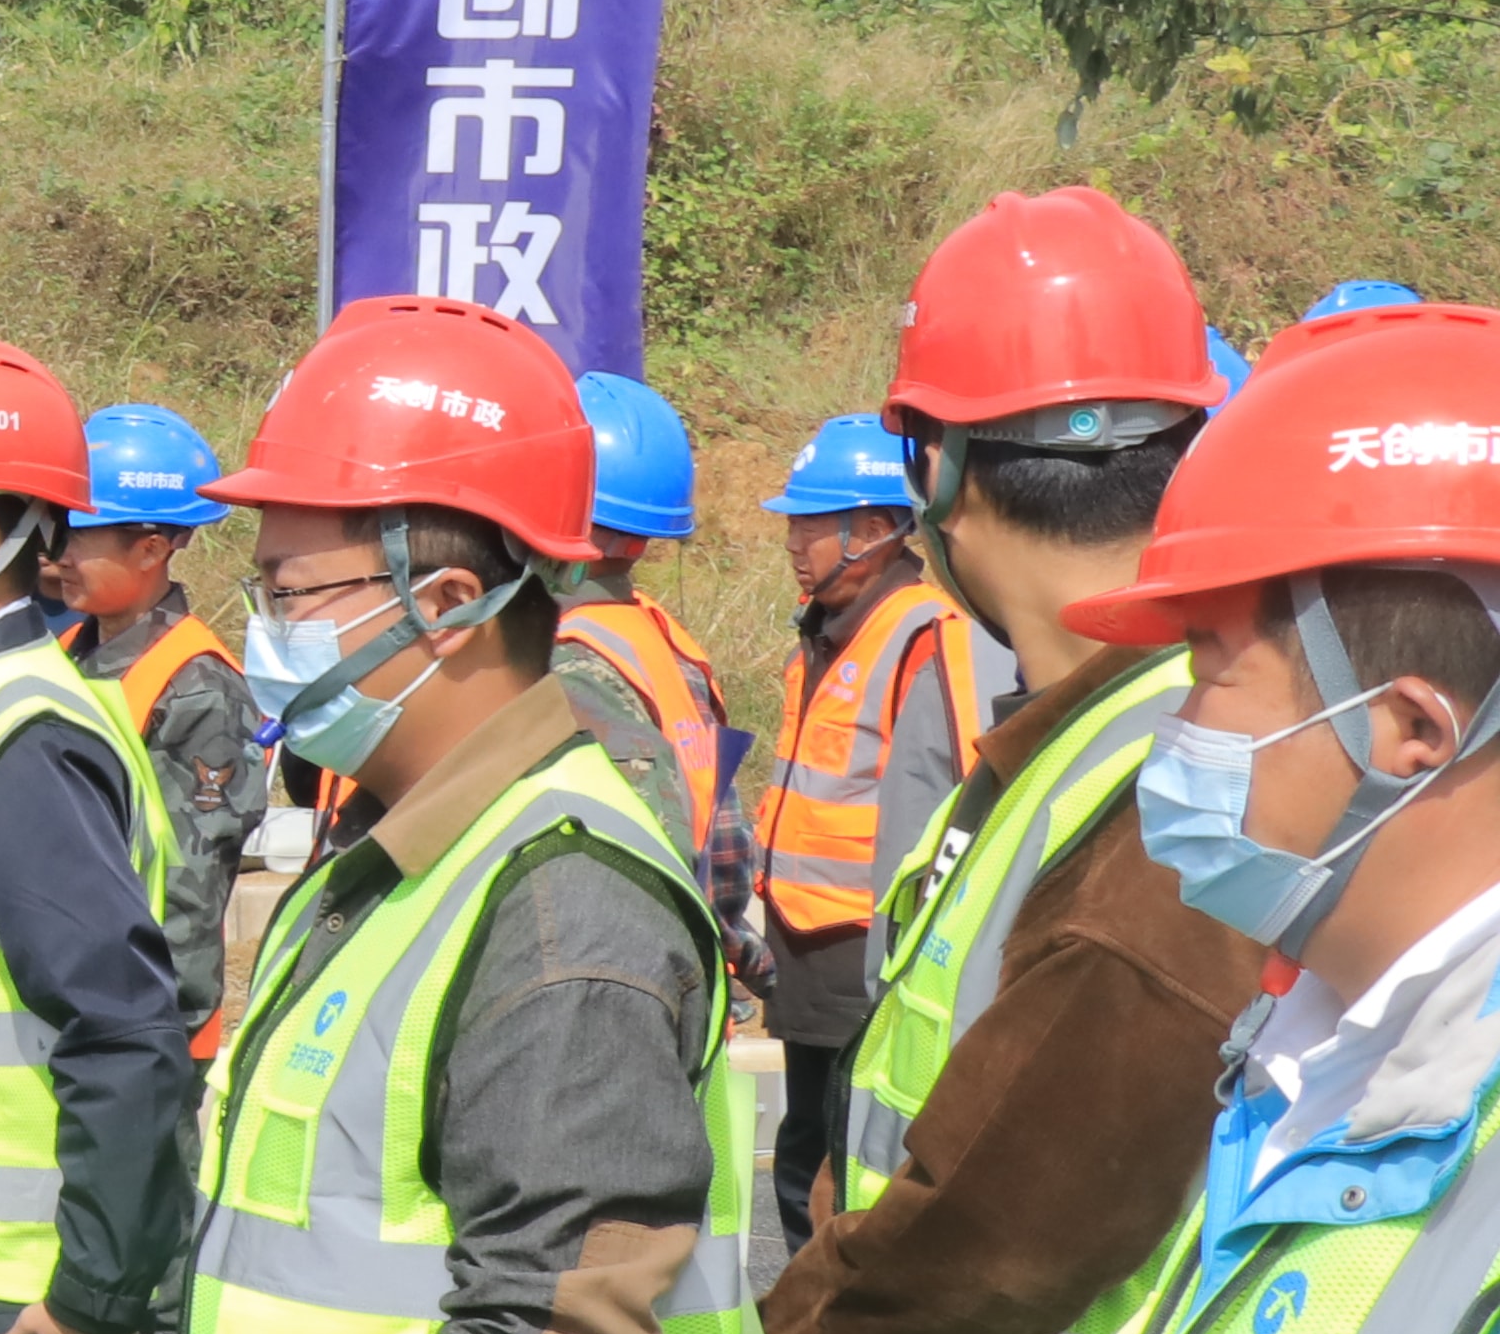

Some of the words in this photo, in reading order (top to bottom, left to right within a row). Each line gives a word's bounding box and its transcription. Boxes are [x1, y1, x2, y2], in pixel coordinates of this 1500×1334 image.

[368, 375, 506, 432] 天创市政
[118, 470, 185, 490] 天创市政
